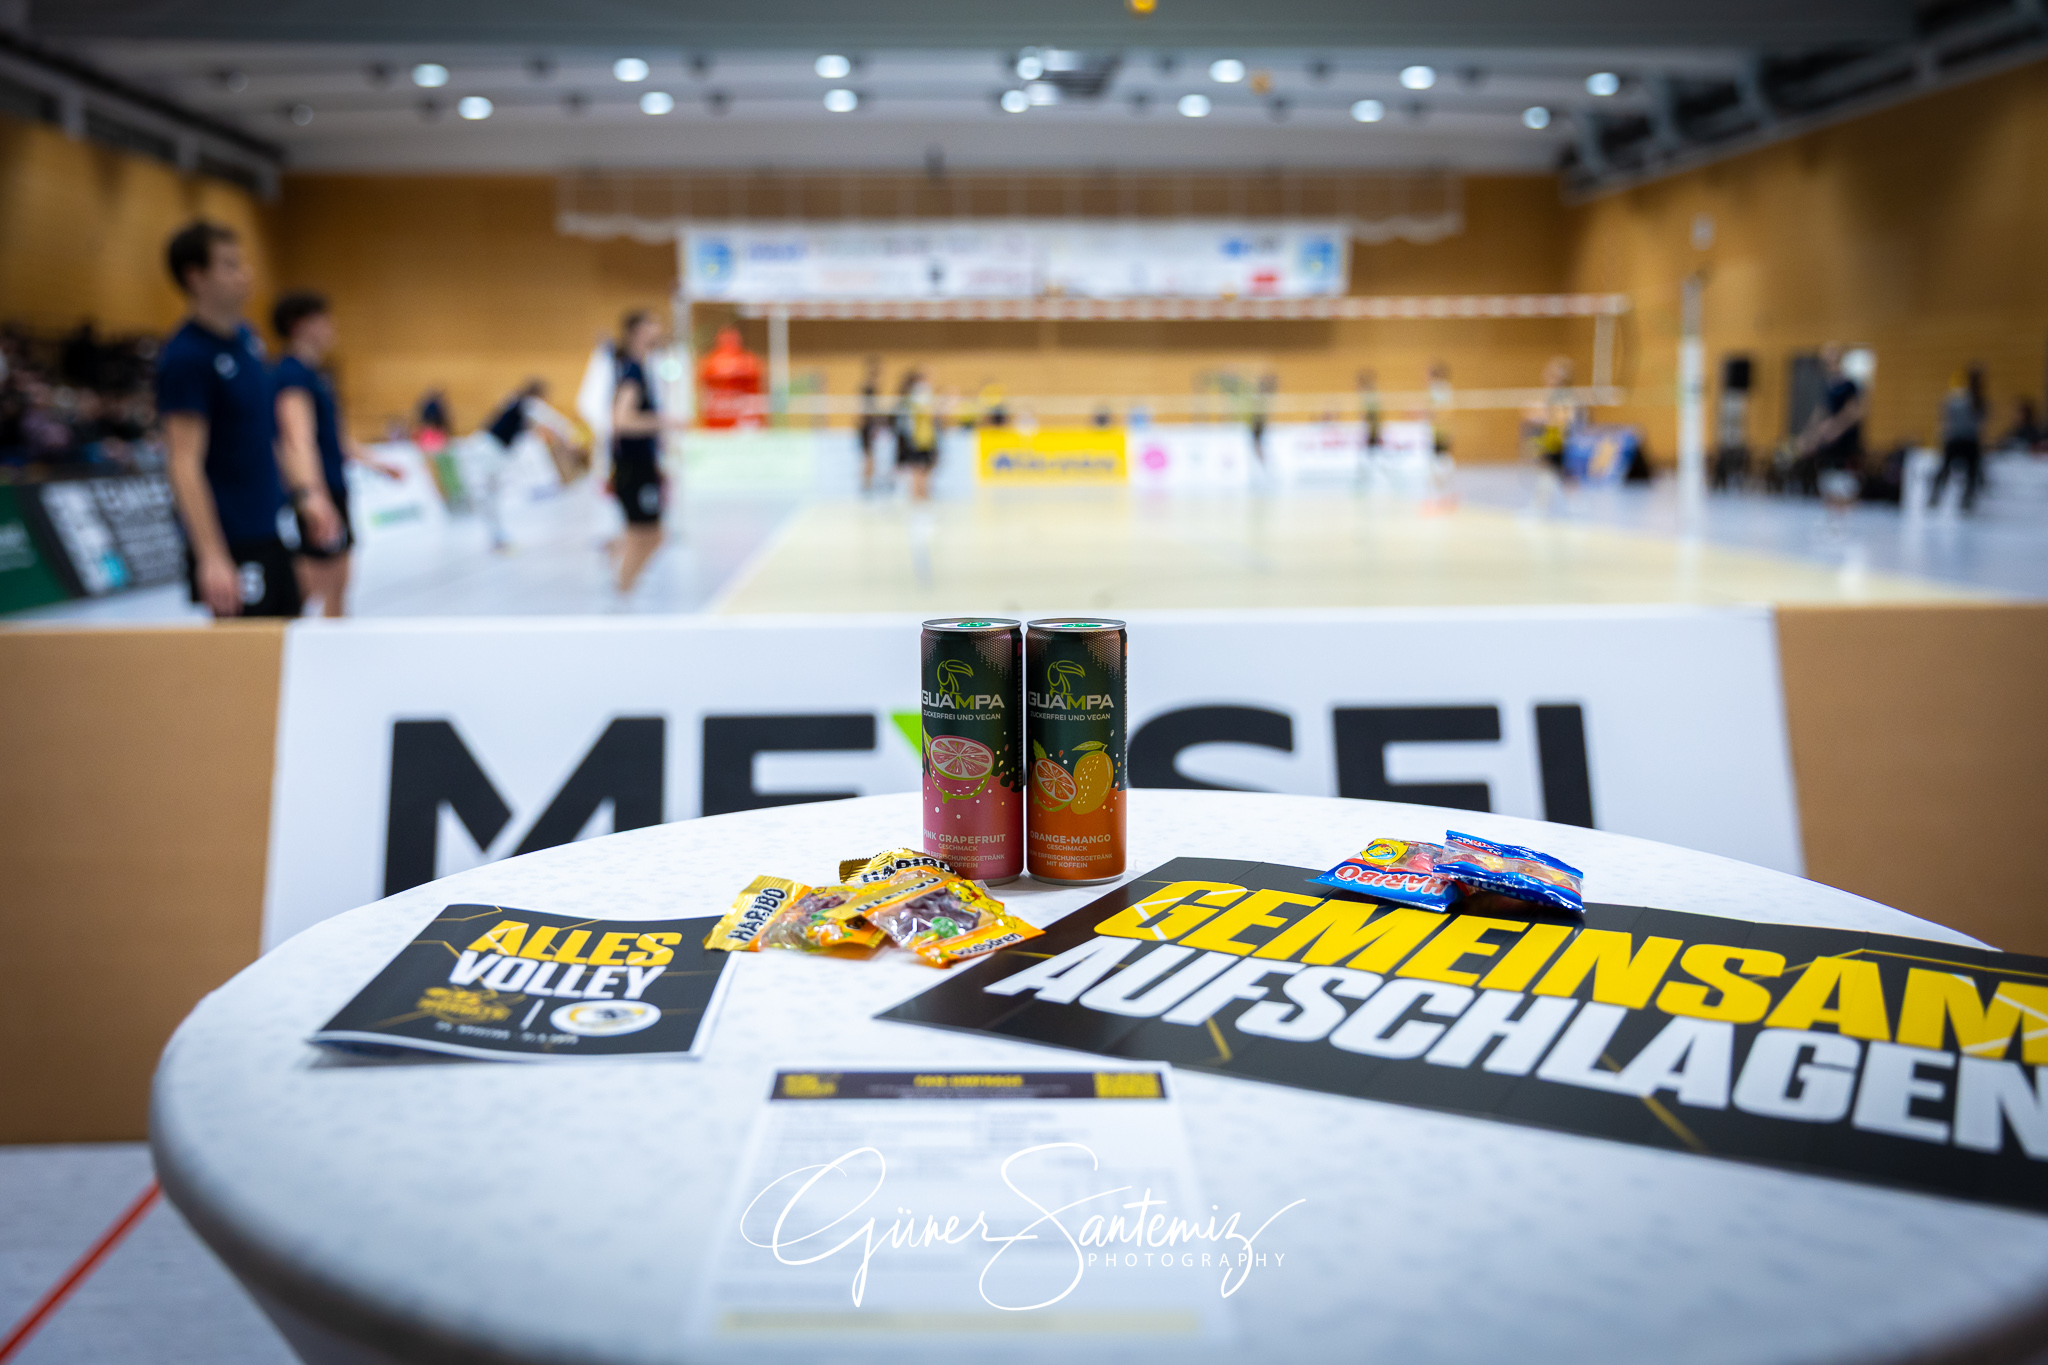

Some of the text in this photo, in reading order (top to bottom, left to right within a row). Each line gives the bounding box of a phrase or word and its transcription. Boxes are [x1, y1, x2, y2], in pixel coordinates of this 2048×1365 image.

[922, 690, 1005, 710] GUAMPA
[1028, 690, 1114, 711] GUAMPA
[923, 711, 1001, 721] ZUCKERFREI UND VEGAN
[1030, 711, 1111, 721] ZUCKERFREI UND VEGAN
[938, 833, 1006, 844] GRAPEFRUIT
[1030, 830, 1111, 844] ORANGE-MANGO
[938, 843, 978, 852] GESCHMACK
[1046, 844, 1087, 852] GESCHMACK
[1038, 852, 1112, 862] ERFRISCHUNGSGETRÄNK
[949, 861, 978, 869] KOFFEIN
[1058, 861, 1088, 869] KOFFEIN
[1335, 864, 1451, 896] HARIBO
[726, 887, 788, 942] HARIBO
[467, 920, 682, 966] ALLES
[448, 950, 667, 999] VOLLEY
[1094, 881, 2048, 1067] GEMEINSAM
[983, 935, 2048, 1163] AUFSCHLAGEN
